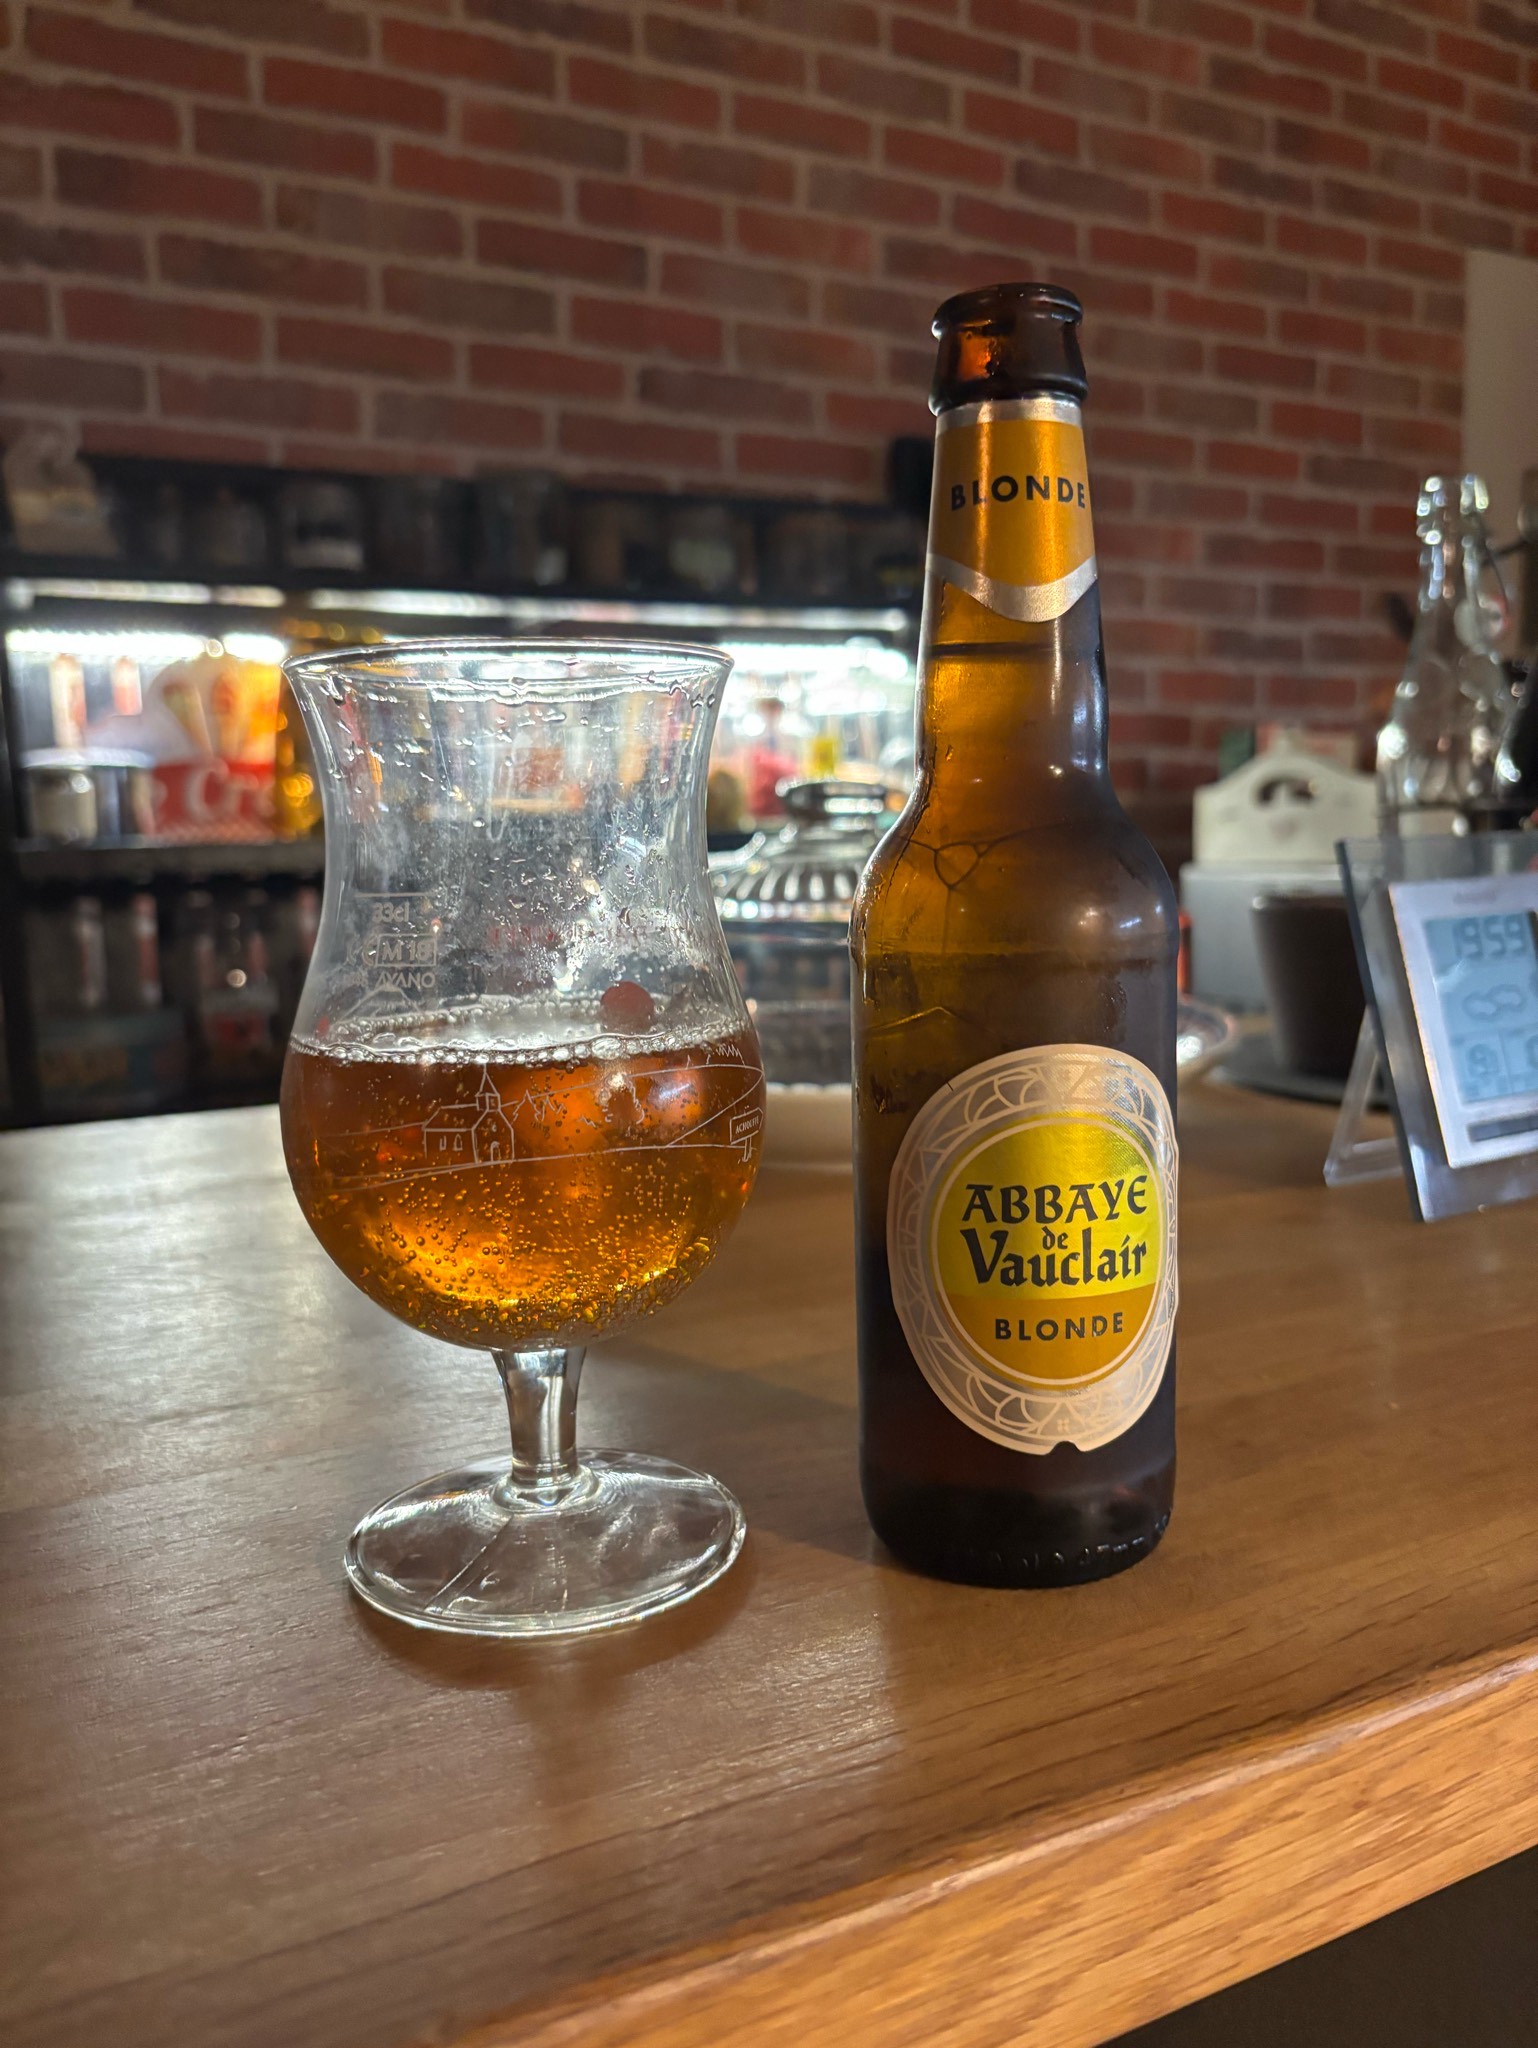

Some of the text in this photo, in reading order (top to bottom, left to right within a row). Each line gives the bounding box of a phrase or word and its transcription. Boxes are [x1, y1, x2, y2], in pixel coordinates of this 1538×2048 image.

[951, 475, 1086, 511] BLONDE
[961, 1174, 1148, 1224] ABBAYE
[1042, 1226, 1068, 1250] de
[960, 1227, 1147, 1287] Vauclair
[995, 1312, 1124, 1341] BLONDE
